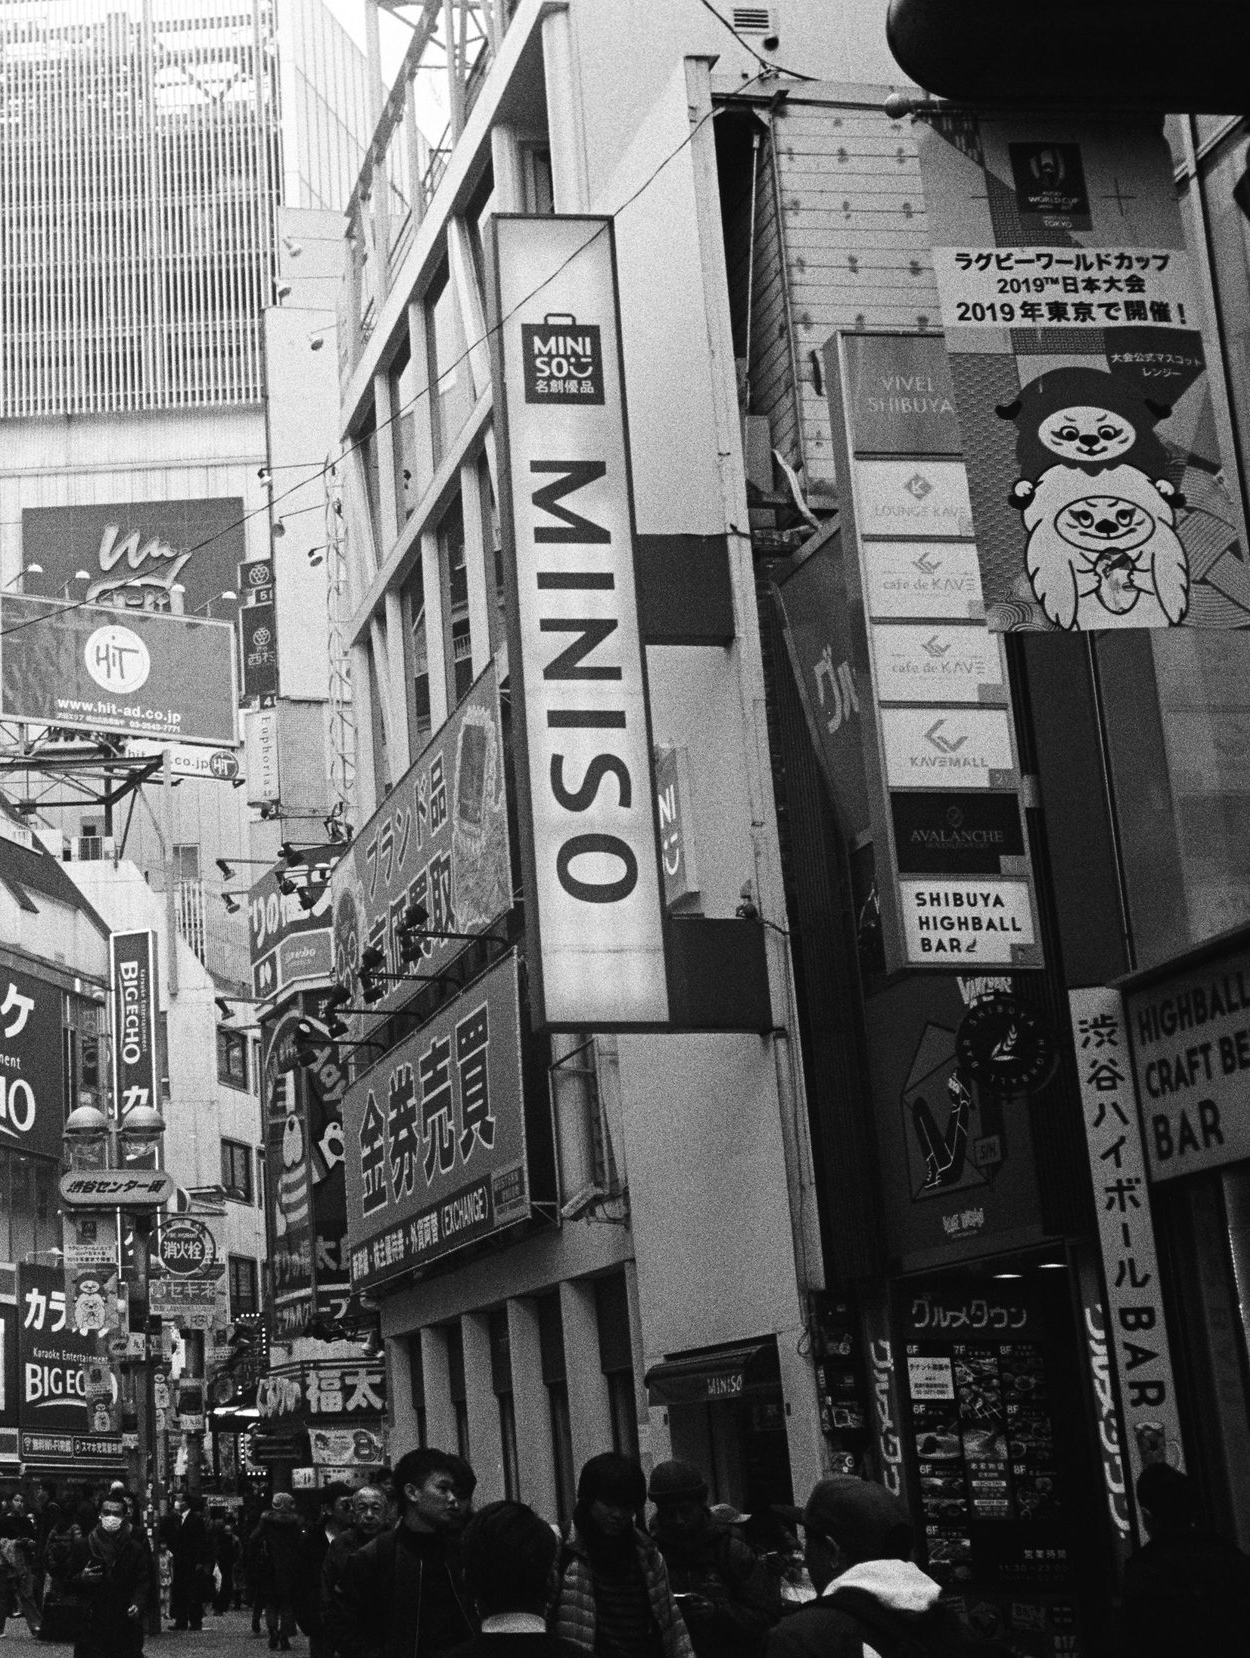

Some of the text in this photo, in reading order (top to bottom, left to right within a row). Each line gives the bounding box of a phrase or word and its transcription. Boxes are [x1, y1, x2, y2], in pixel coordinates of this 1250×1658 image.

[954, 251, 1171, 272] ラグビーワールドカップ
[533, 335, 592, 357] MINI
[1110, 353, 1202, 368] 大会公式マスコット
[1142, 367, 1183, 379] レンジー
[882, 375, 936, 392] VIVEL
[868, 397, 956, 414] SHIBUYA
[529, 459, 638, 904] MINISO
[57, 698, 182, 724] www.hit-ad.co.jp
[365, 750, 448, 901] ブランド品
[910, 829, 1005, 843] AVALANCHE
[914, 891, 1006, 908] SHIBUYA
[917, 915, 1022, 932] HIGHBALL
[920, 937, 962, 953] BAR
[120, 961, 141, 1065] BIG ECHO
[1137, 970, 1250, 1047] HIGHBALL
[1145, 1041, 1214, 1098] CRAFT
[1152, 1098, 1225, 1161] BAR
[66, 1178, 167, 1195] 渋谷センター街
[163, 1240, 202, 1260] 消火栓
[33, 1347, 61, 1361] Karaoke
[906, 1344, 920, 1355] 6F
[953, 1344, 966, 1355] 7F
[999, 1344, 1012, 1356] 8F
[25, 1362, 63, 1403] BIG
[707, 1374, 744, 1396] MINISO
[912, 1403, 1020, 1415] 6F 8F
[918, 1463, 1027, 1475] 6F 8F
[924, 1524, 939, 1536] 6F
